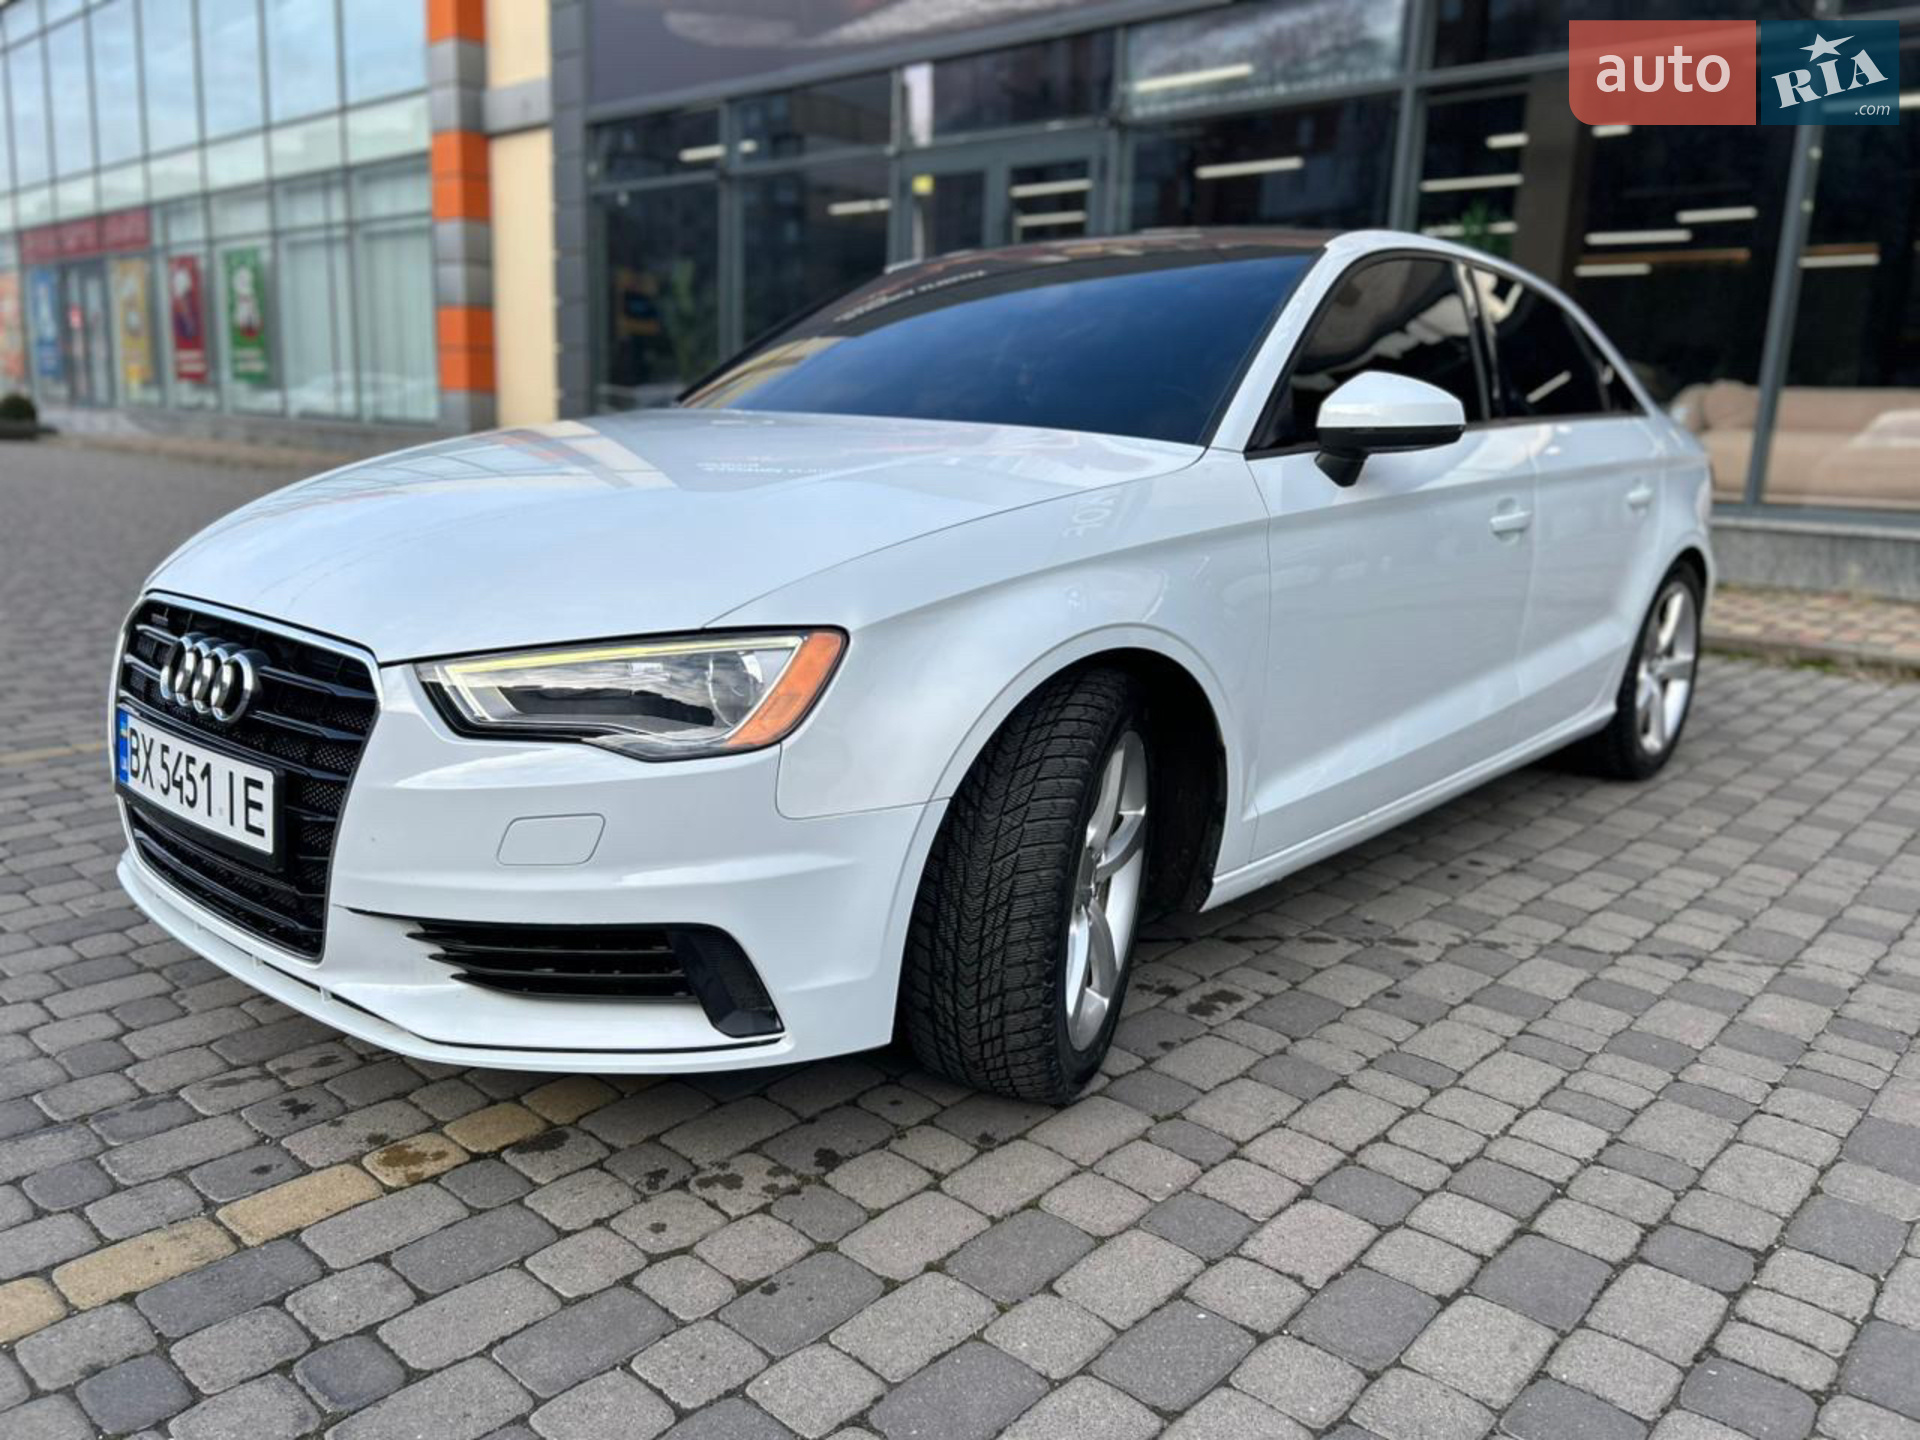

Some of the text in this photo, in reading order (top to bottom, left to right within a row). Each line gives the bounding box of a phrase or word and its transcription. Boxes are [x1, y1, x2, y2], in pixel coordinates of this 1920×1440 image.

[129, 726, 266, 838] BX 5451 IE
